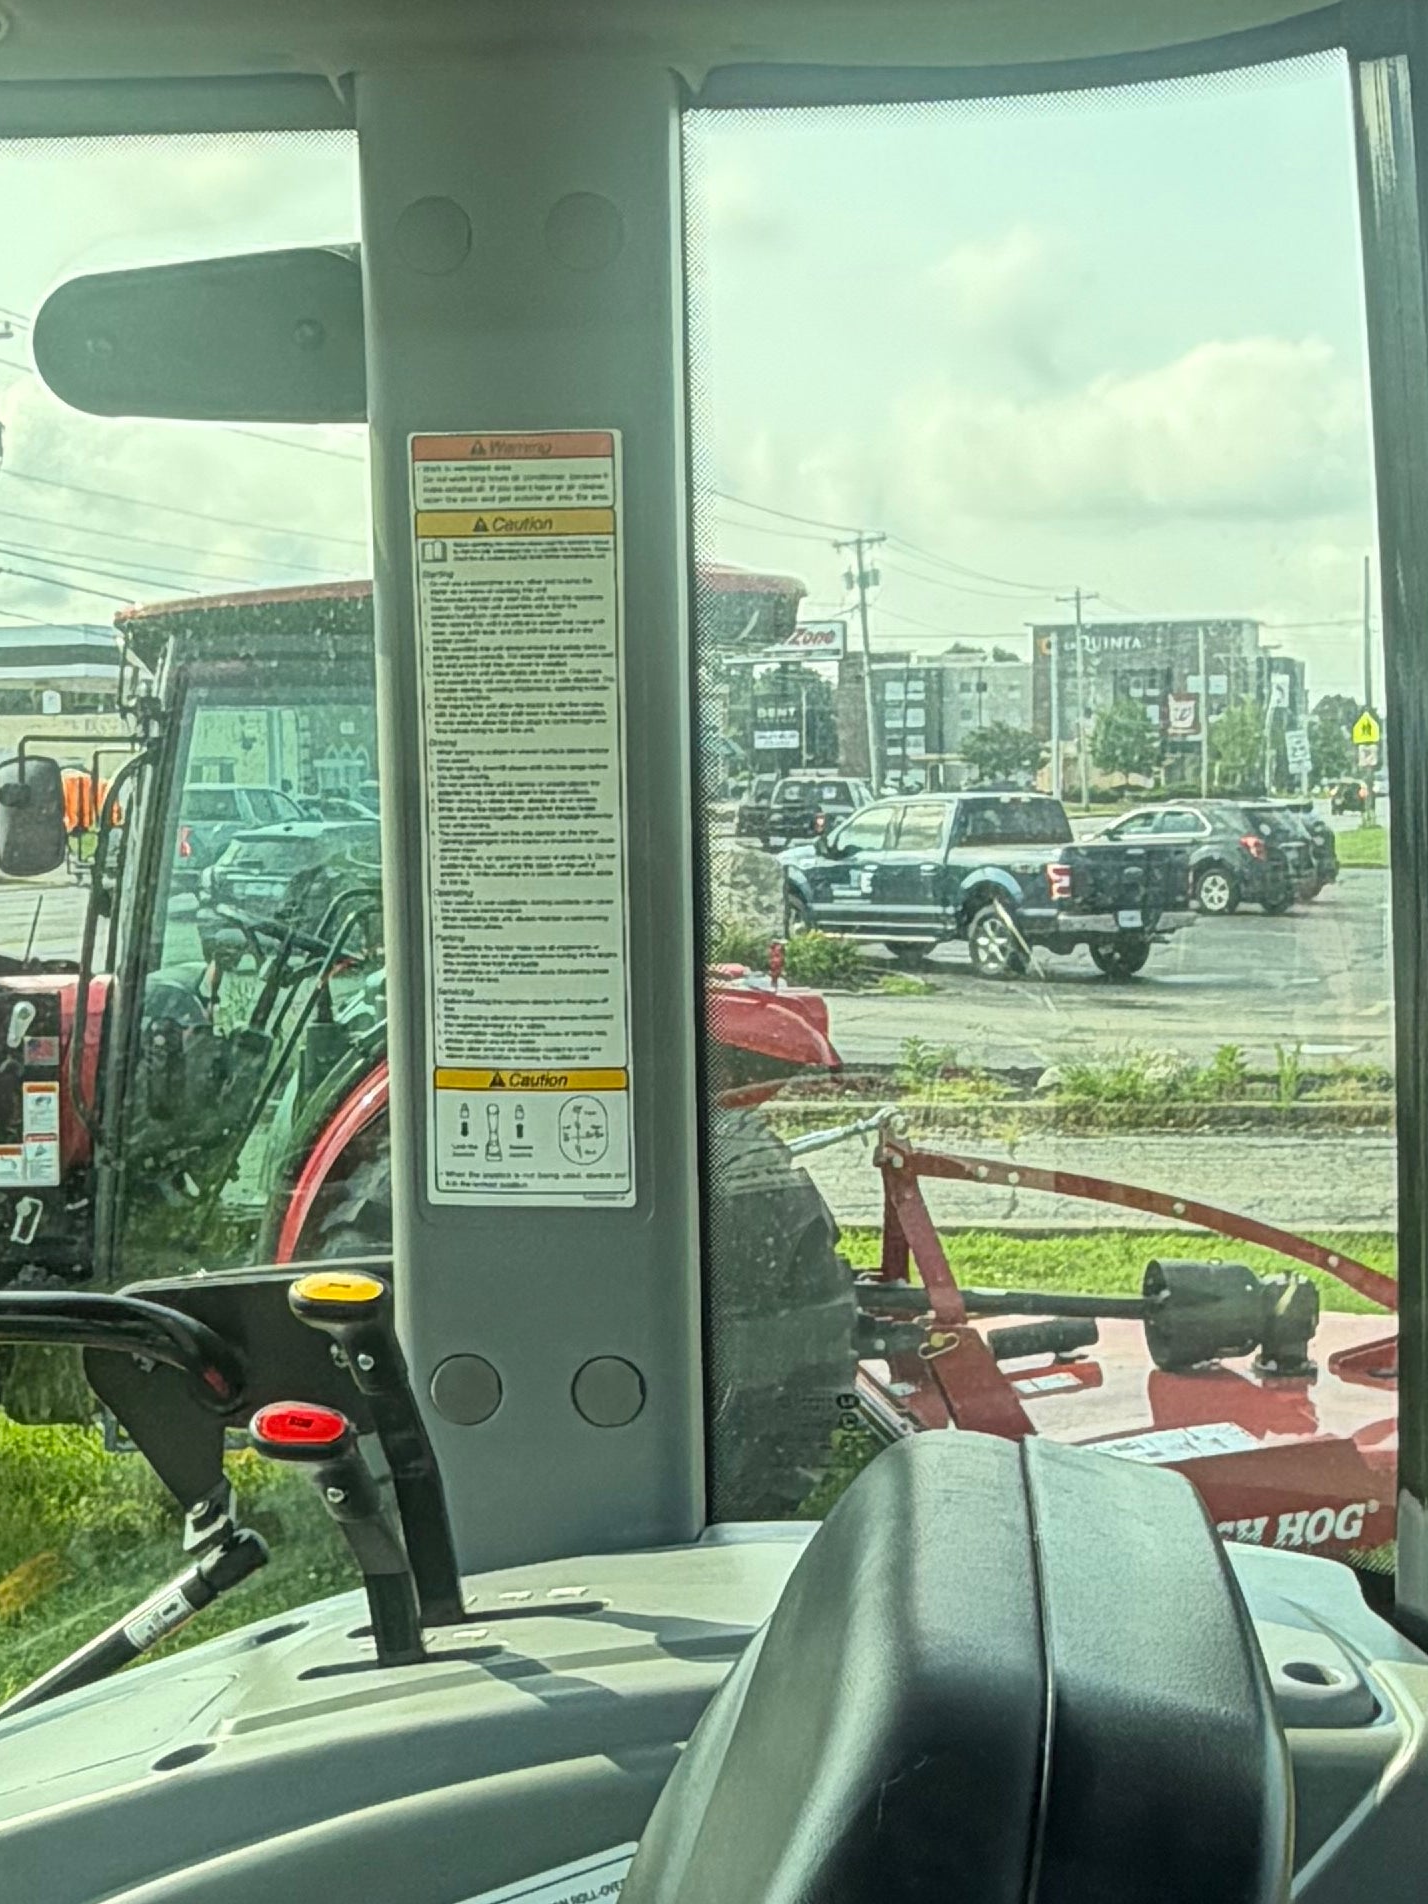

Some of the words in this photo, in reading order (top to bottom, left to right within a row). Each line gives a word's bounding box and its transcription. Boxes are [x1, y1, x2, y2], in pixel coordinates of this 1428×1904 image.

[489, 441, 552, 456] Warning
[492, 516, 553, 532] Caution
[788, 627, 836, 646] Zone
[1082, 635, 1143, 653] QUINTA
[509, 1072, 568, 1087] Caution
[1273, 1503, 1366, 1547] HOG
